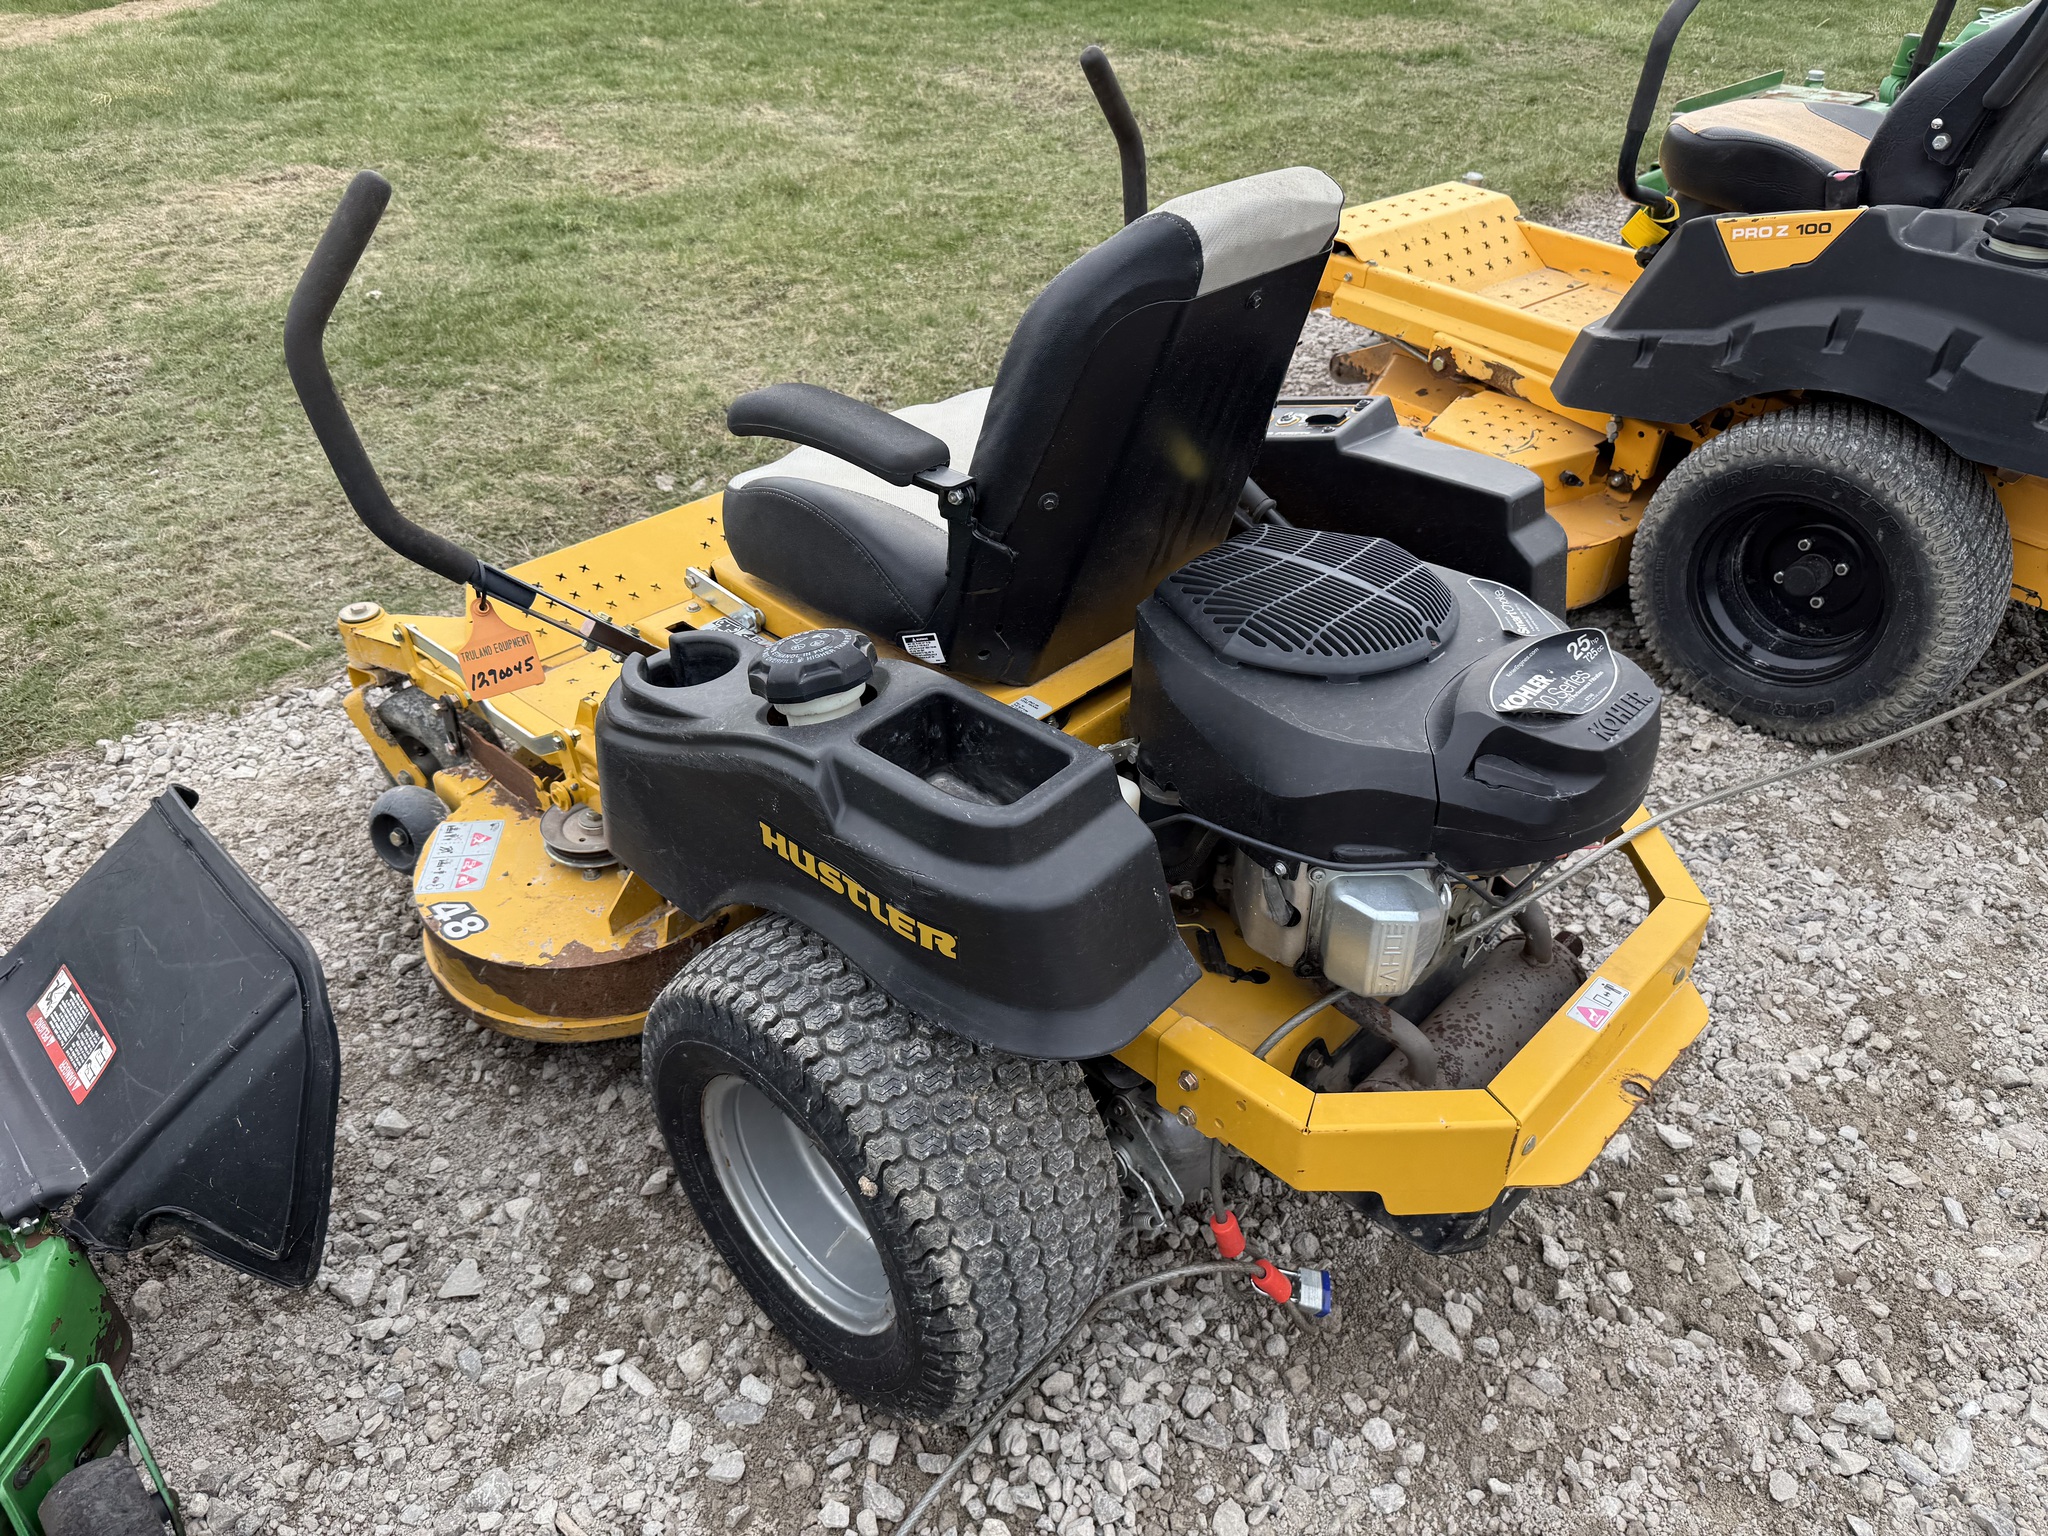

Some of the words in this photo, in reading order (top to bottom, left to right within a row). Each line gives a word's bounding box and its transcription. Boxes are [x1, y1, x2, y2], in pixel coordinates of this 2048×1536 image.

[1732, 226, 1773, 240] PRO
[1775, 225, 1789, 237] Z
[1796, 222, 1832, 235] 100
[460, 645, 493, 663] TRULAND
[492, 634, 532, 655] EQUIPMENT
[471, 655, 535, 692] 1290045
[1547, 669, 1592, 700] Series
[1499, 674, 1554, 711] KOHLER
[1587, 690, 1654, 742] KOHLER
[758, 820, 958, 960] HUSTLER
[426, 901, 490, 941] 48
[33, 1016, 53, 1042] PELIGRO
[57, 1059, 79, 1086] DANGER
